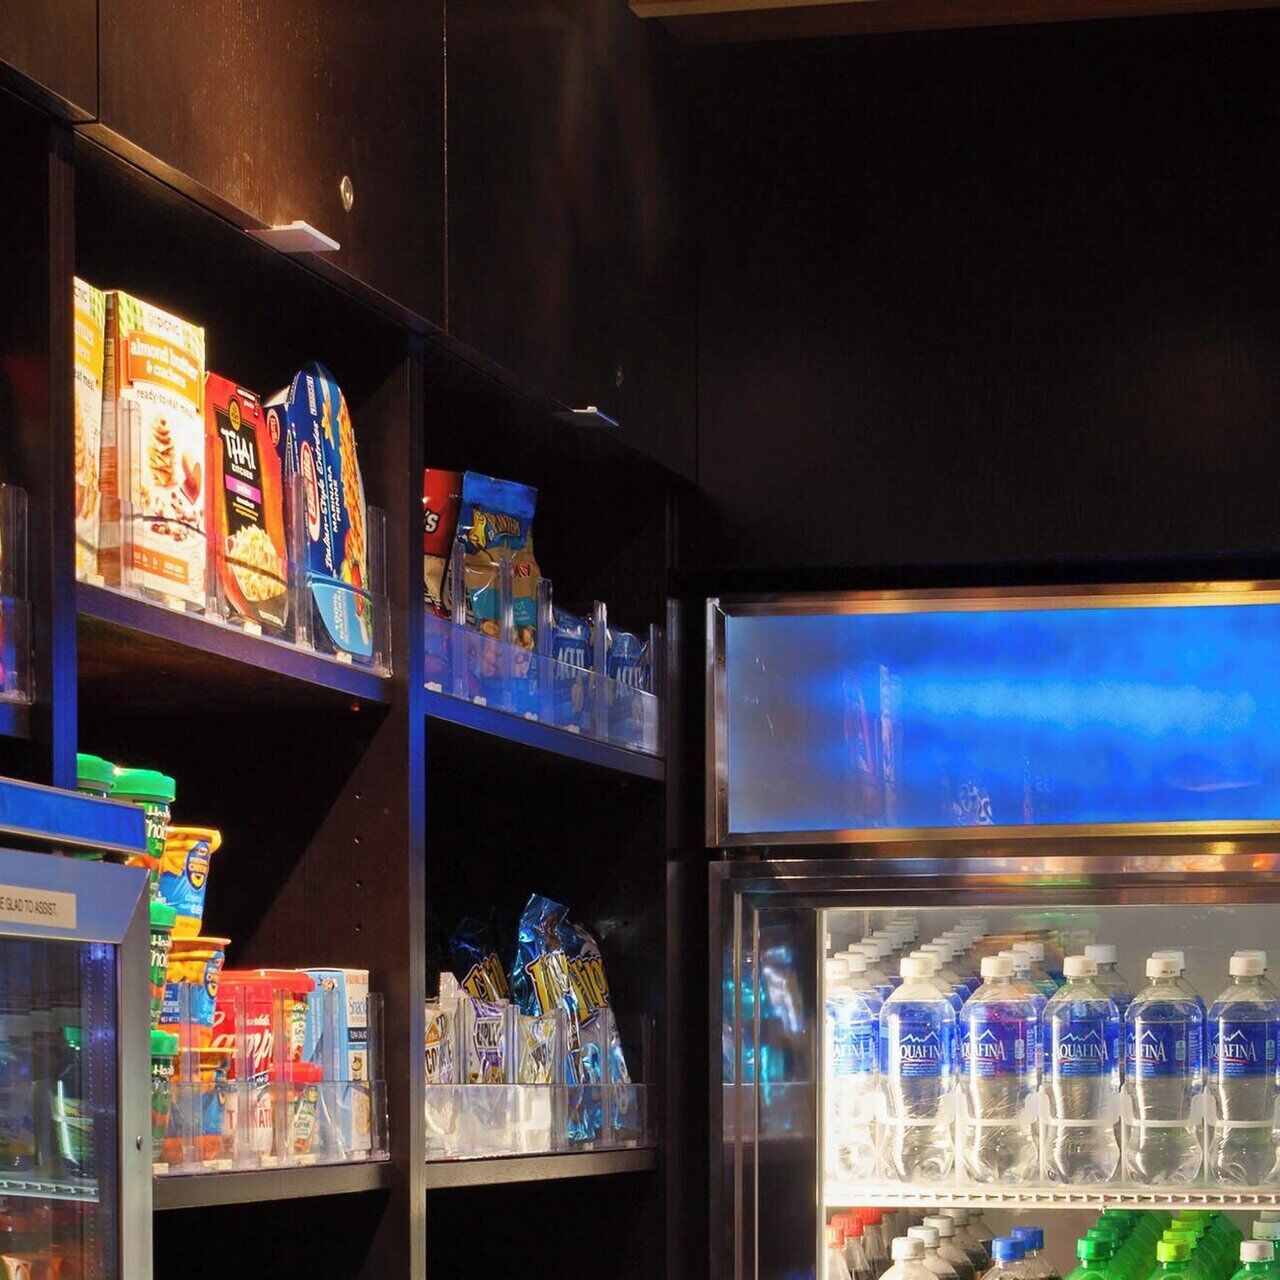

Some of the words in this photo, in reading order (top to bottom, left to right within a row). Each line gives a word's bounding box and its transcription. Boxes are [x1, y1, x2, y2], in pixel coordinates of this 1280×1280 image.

[129, 338, 168, 364] almond
[221, 427, 257, 471] THAI
[326, 464, 340, 534] MARINARA
[333, 478, 343, 522] PENNE
[6, 897, 24, 912] GLAD
[24, 899, 34, 913] TO
